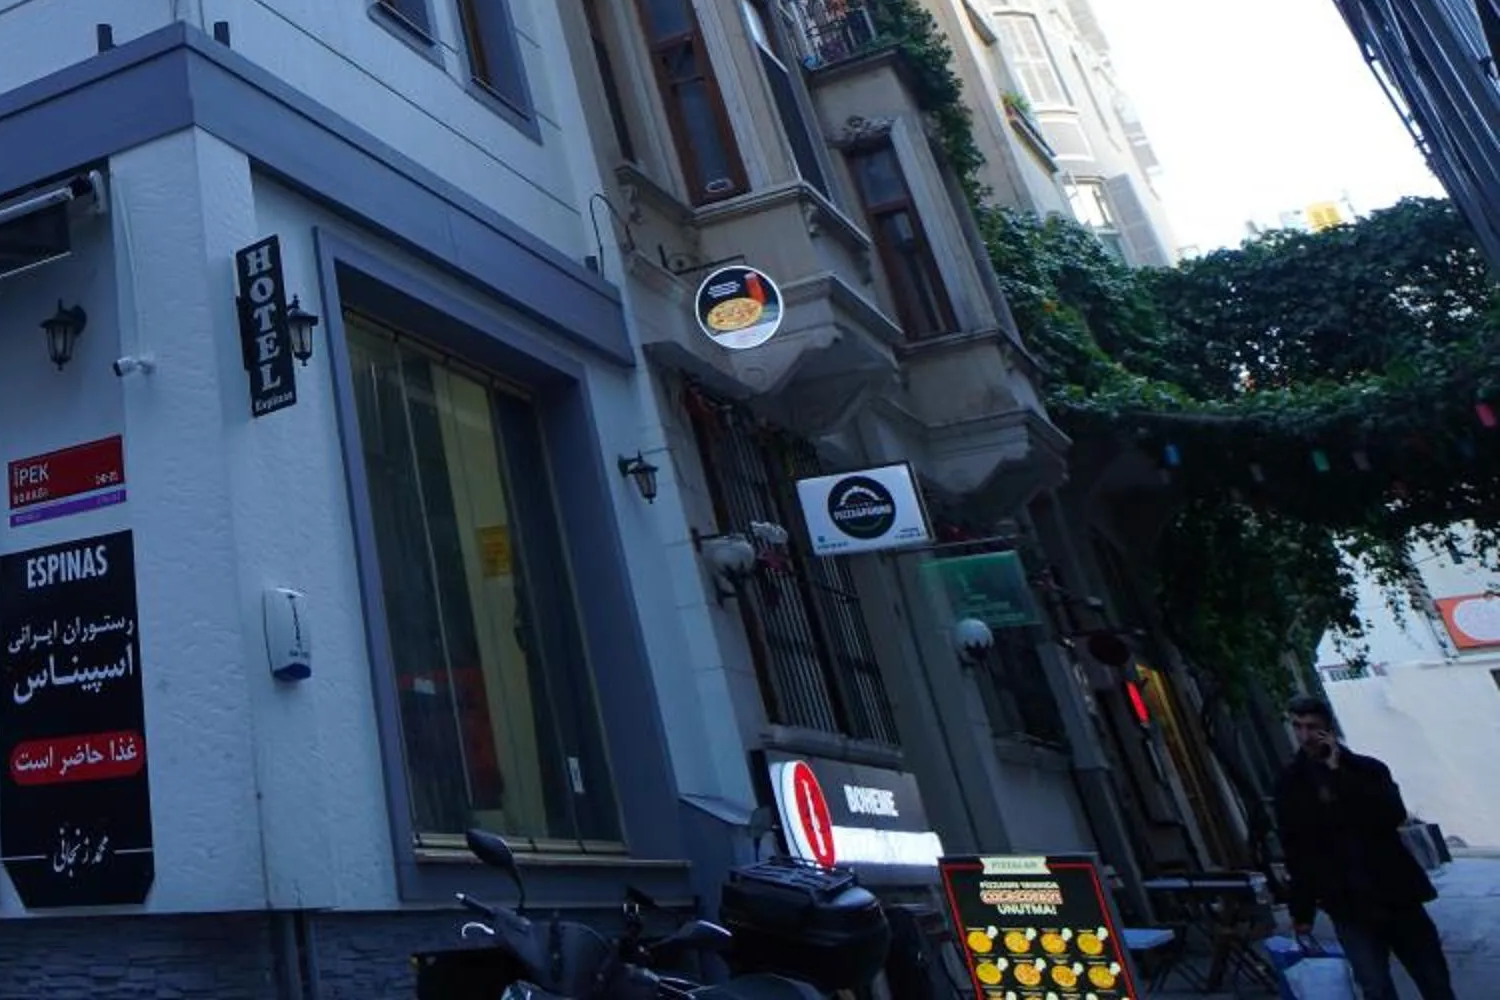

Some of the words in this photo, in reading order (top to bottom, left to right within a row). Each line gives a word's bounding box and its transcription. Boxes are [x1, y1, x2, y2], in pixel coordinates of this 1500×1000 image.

[246, 245, 281, 393] HOTEL
[27, 545, 108, 589] ESPINAS
[62, 614, 135, 645] رستوران
[13, 642, 134, 704] اسپیناس
[15, 746, 54, 771] است
[59, 742, 104, 776] حاضر
[109, 736, 137, 761] غذا
